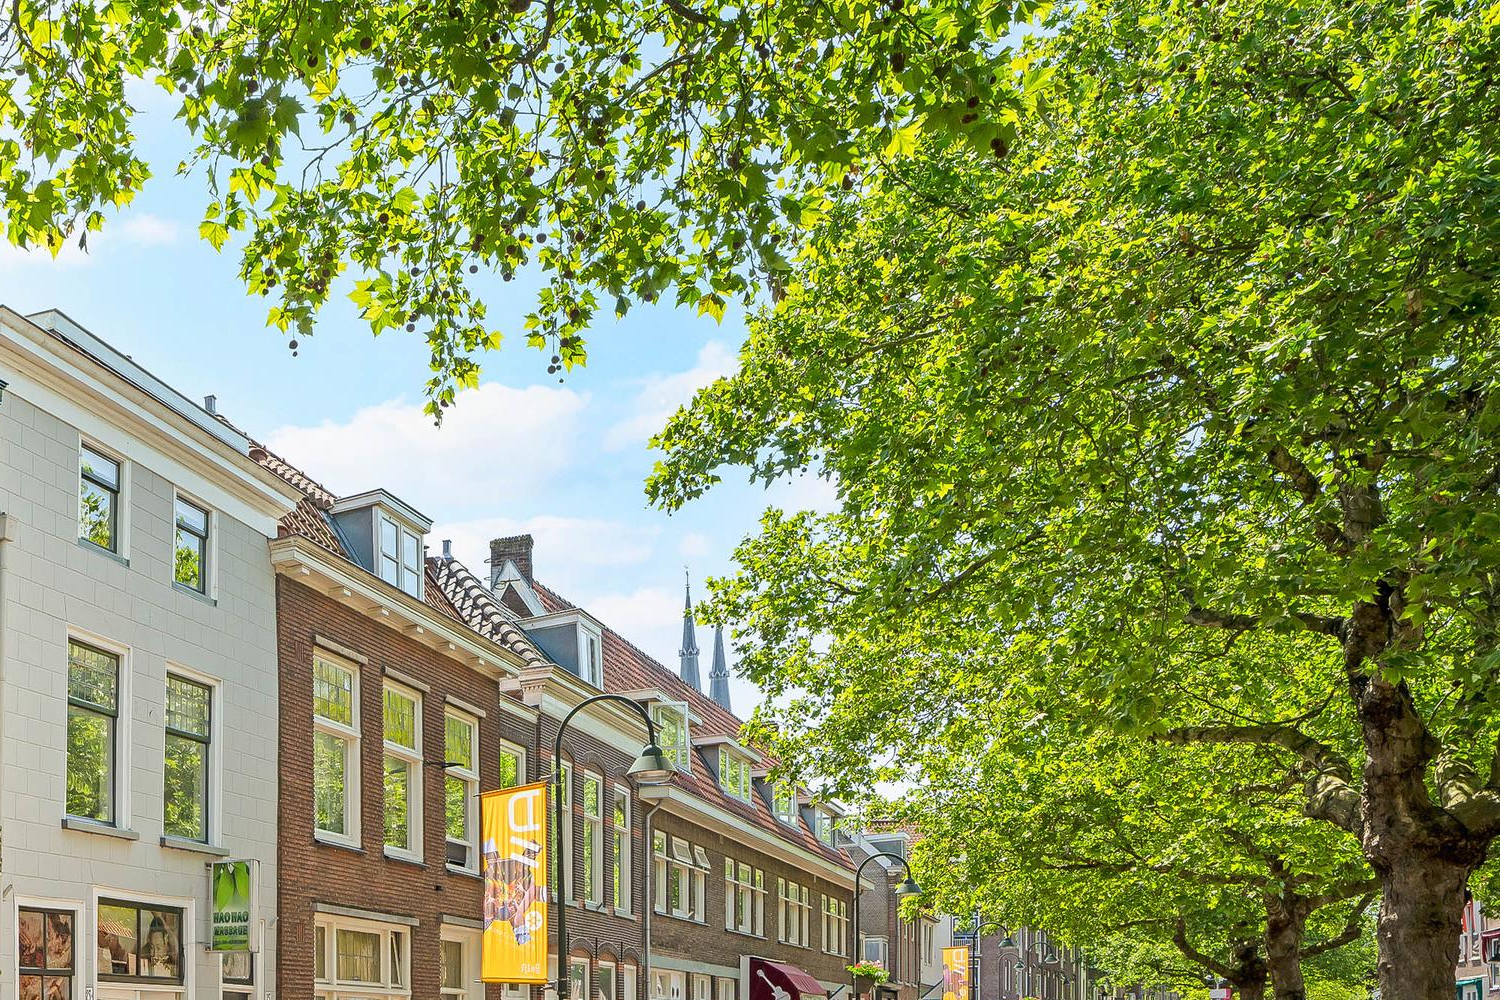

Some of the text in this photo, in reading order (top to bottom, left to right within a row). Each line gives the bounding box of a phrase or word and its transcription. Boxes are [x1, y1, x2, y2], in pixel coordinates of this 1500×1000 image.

[213, 911, 249, 923] HAO HAO
[213, 925, 248, 936] MASSAGE
